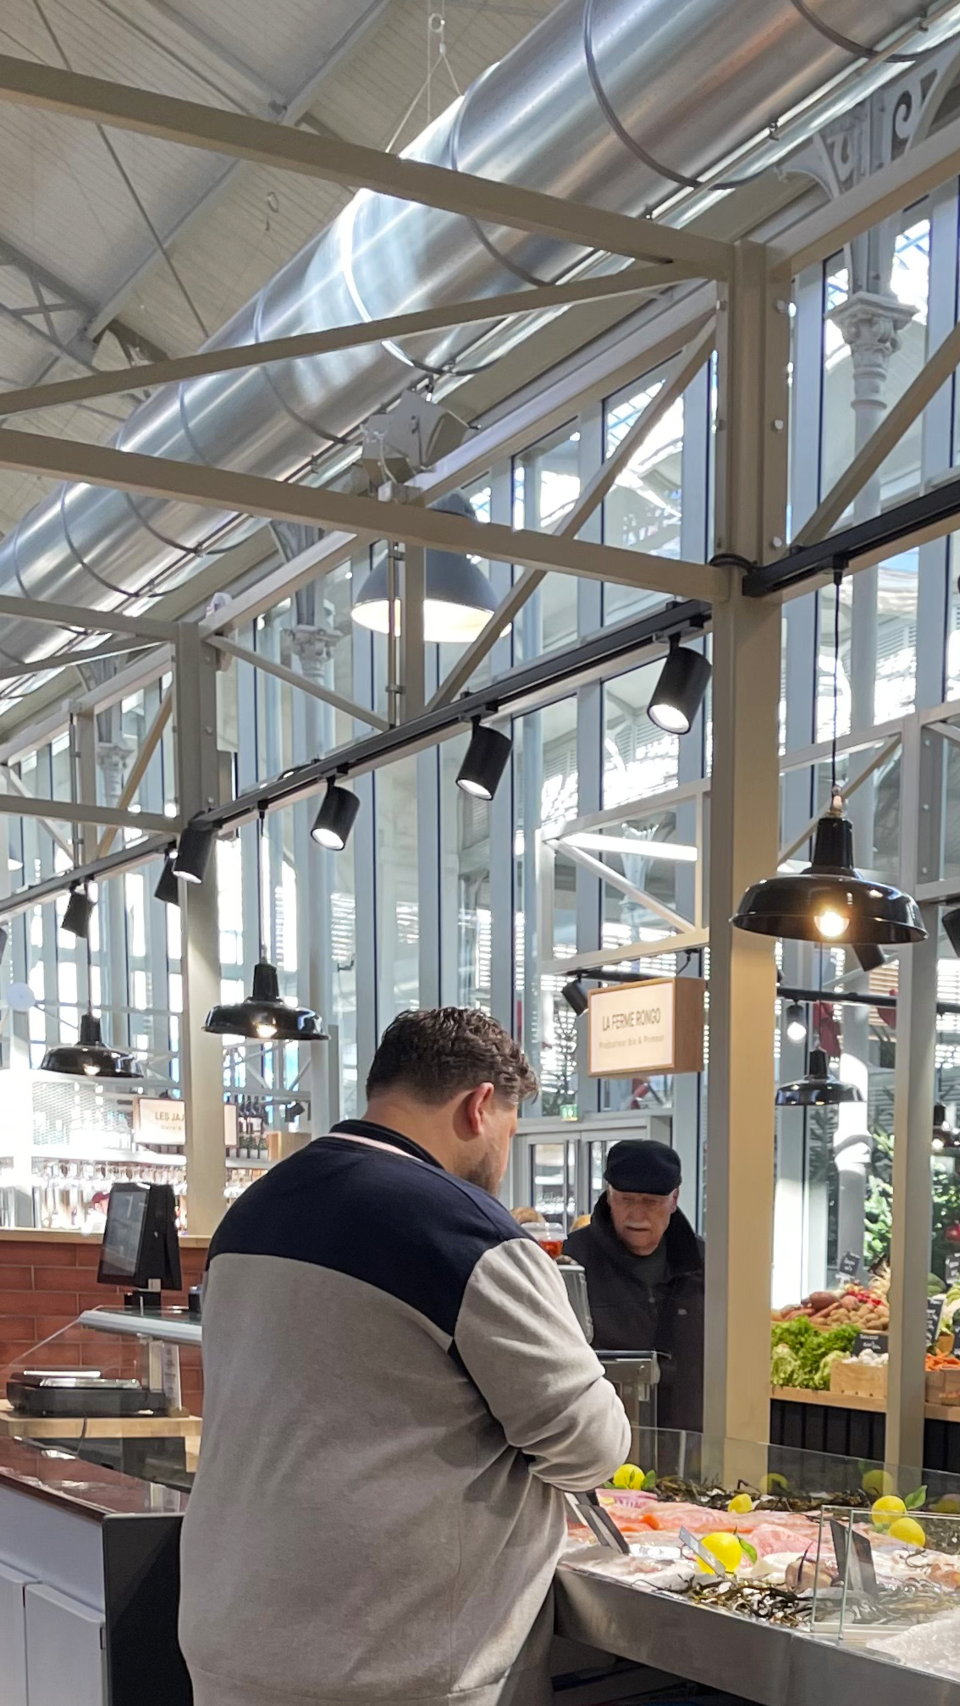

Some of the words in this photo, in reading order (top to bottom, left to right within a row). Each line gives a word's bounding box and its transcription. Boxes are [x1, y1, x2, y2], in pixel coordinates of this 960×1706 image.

[602, 1015, 611, 1031] LA
[611, 1012, 635, 1030] FERME
[636, 1007, 662, 1027] RONGO
[155, 1111, 170, 1121] LES
